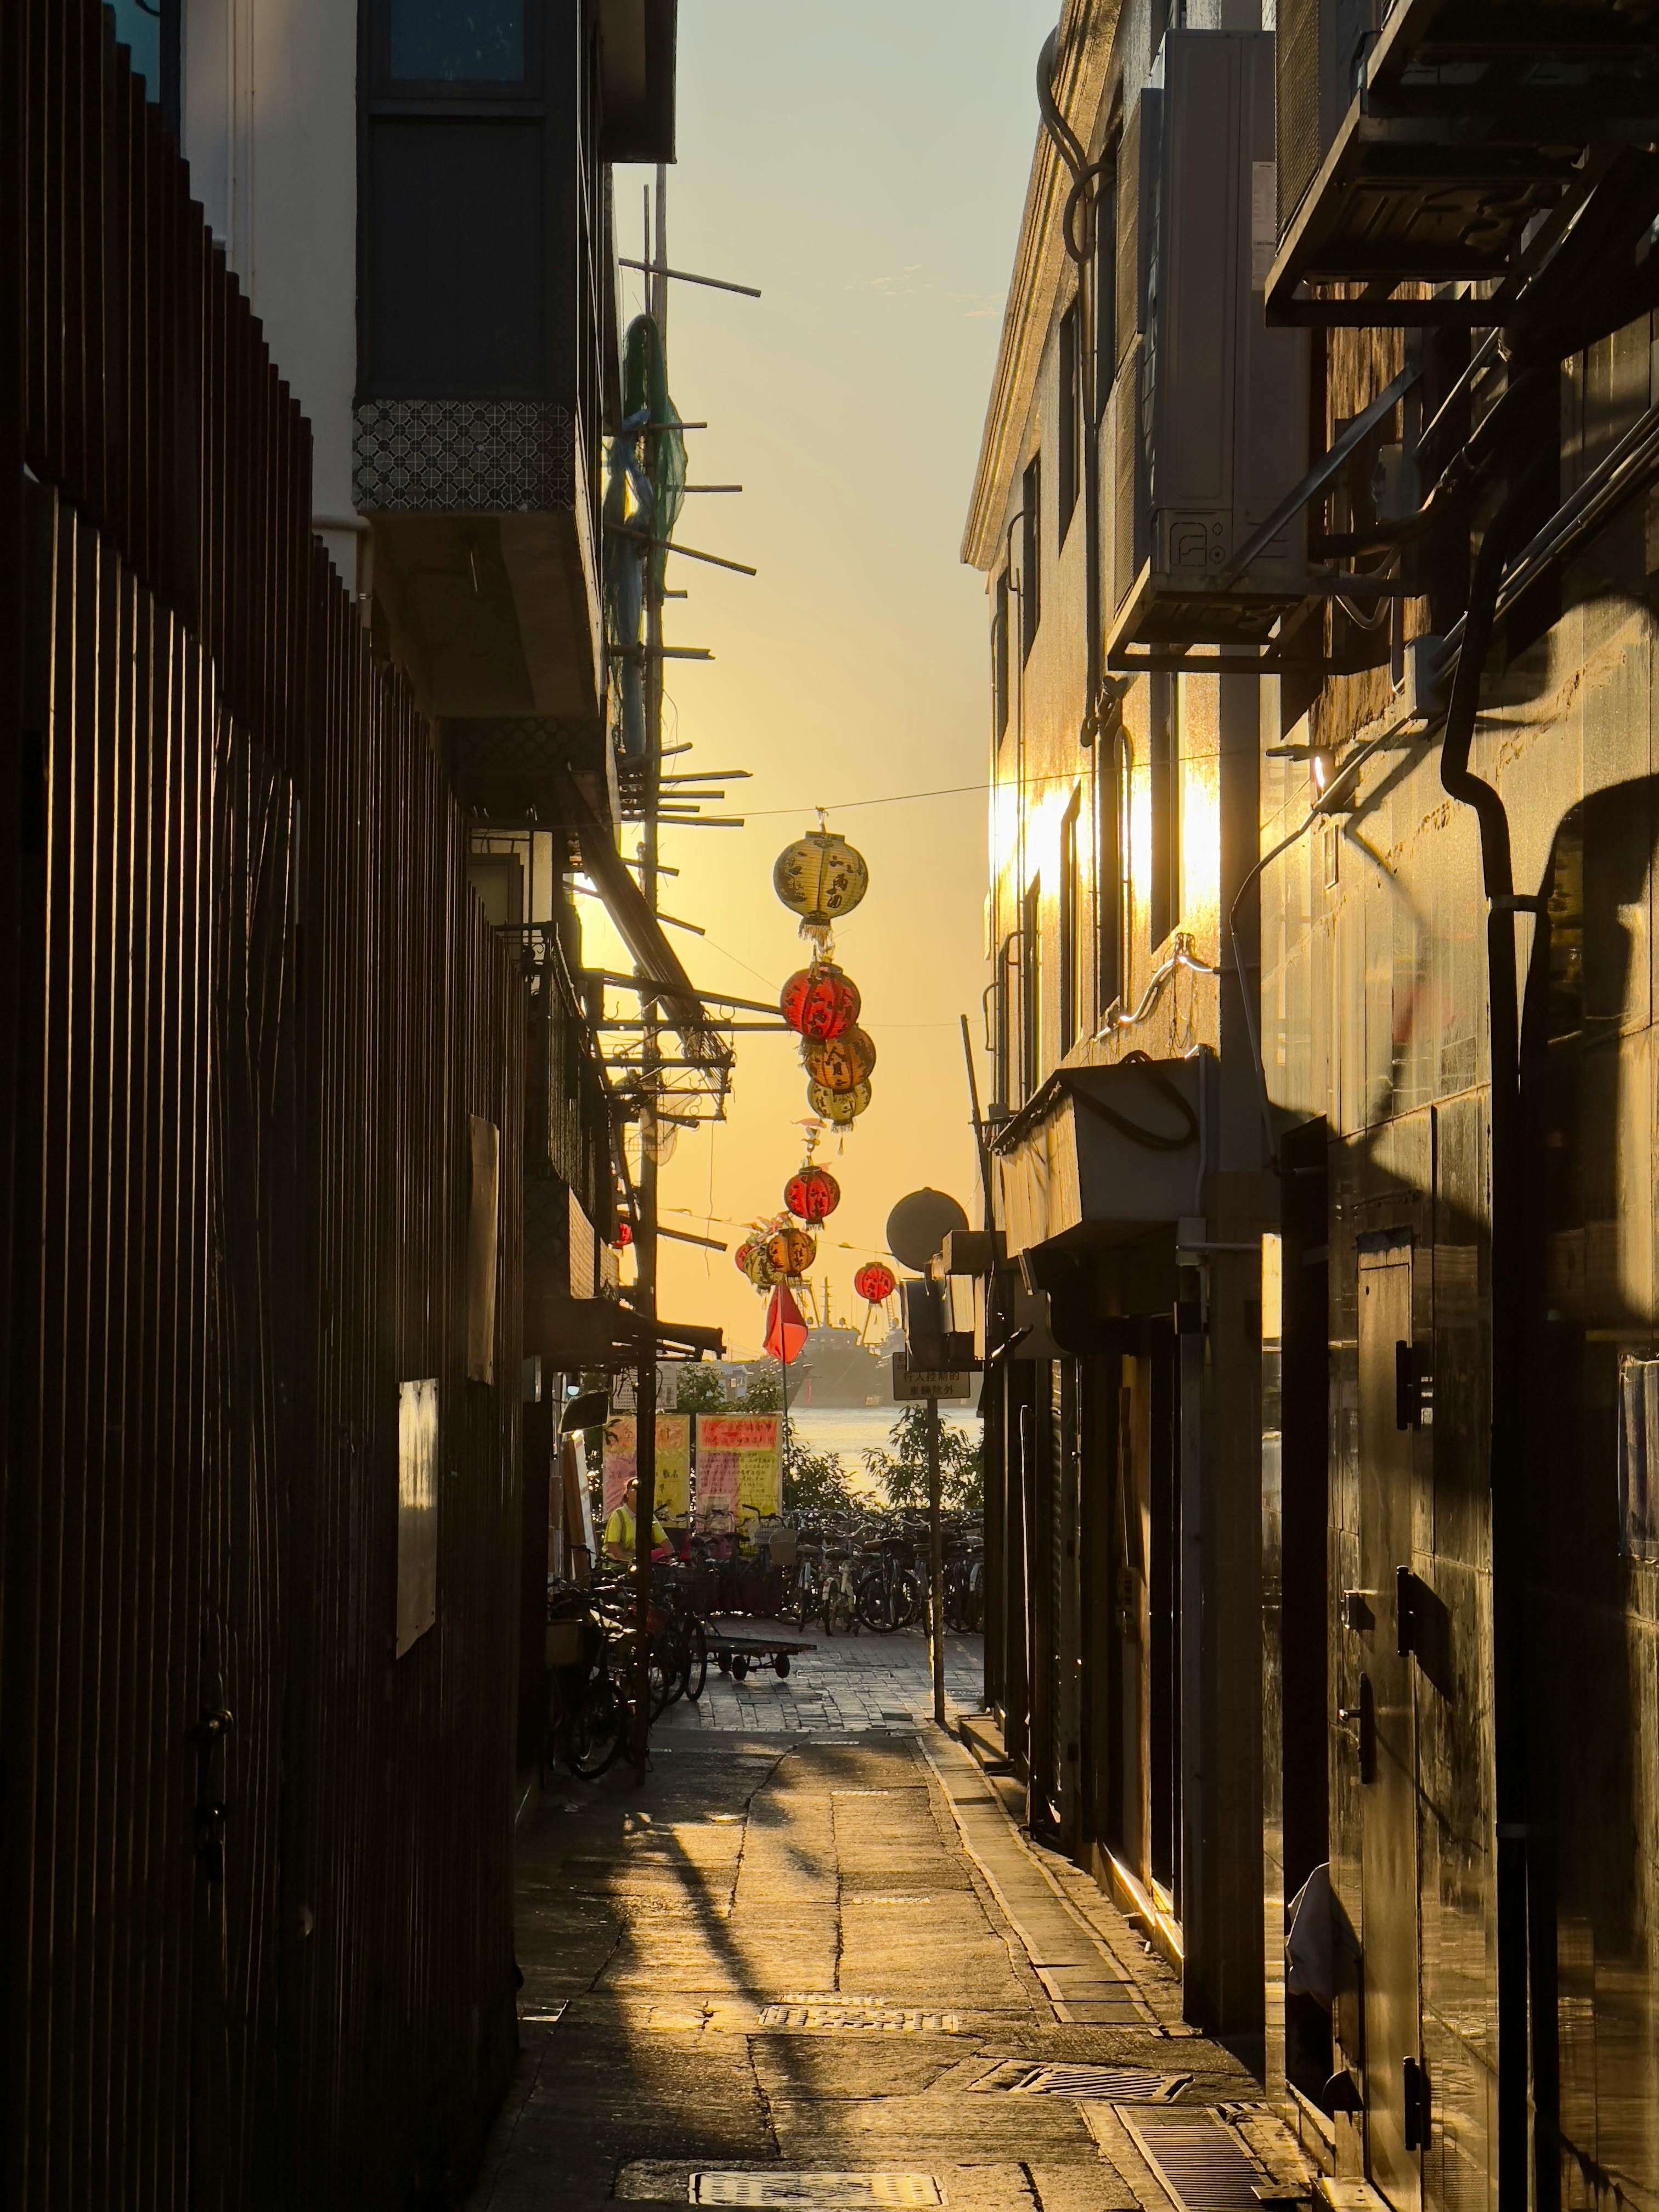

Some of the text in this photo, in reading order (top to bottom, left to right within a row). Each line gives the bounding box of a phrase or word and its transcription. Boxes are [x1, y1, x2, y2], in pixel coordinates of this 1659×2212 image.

[904, 1372, 960, 1383] 行人控制的
[909, 1385, 954, 1396] 車輛除外
